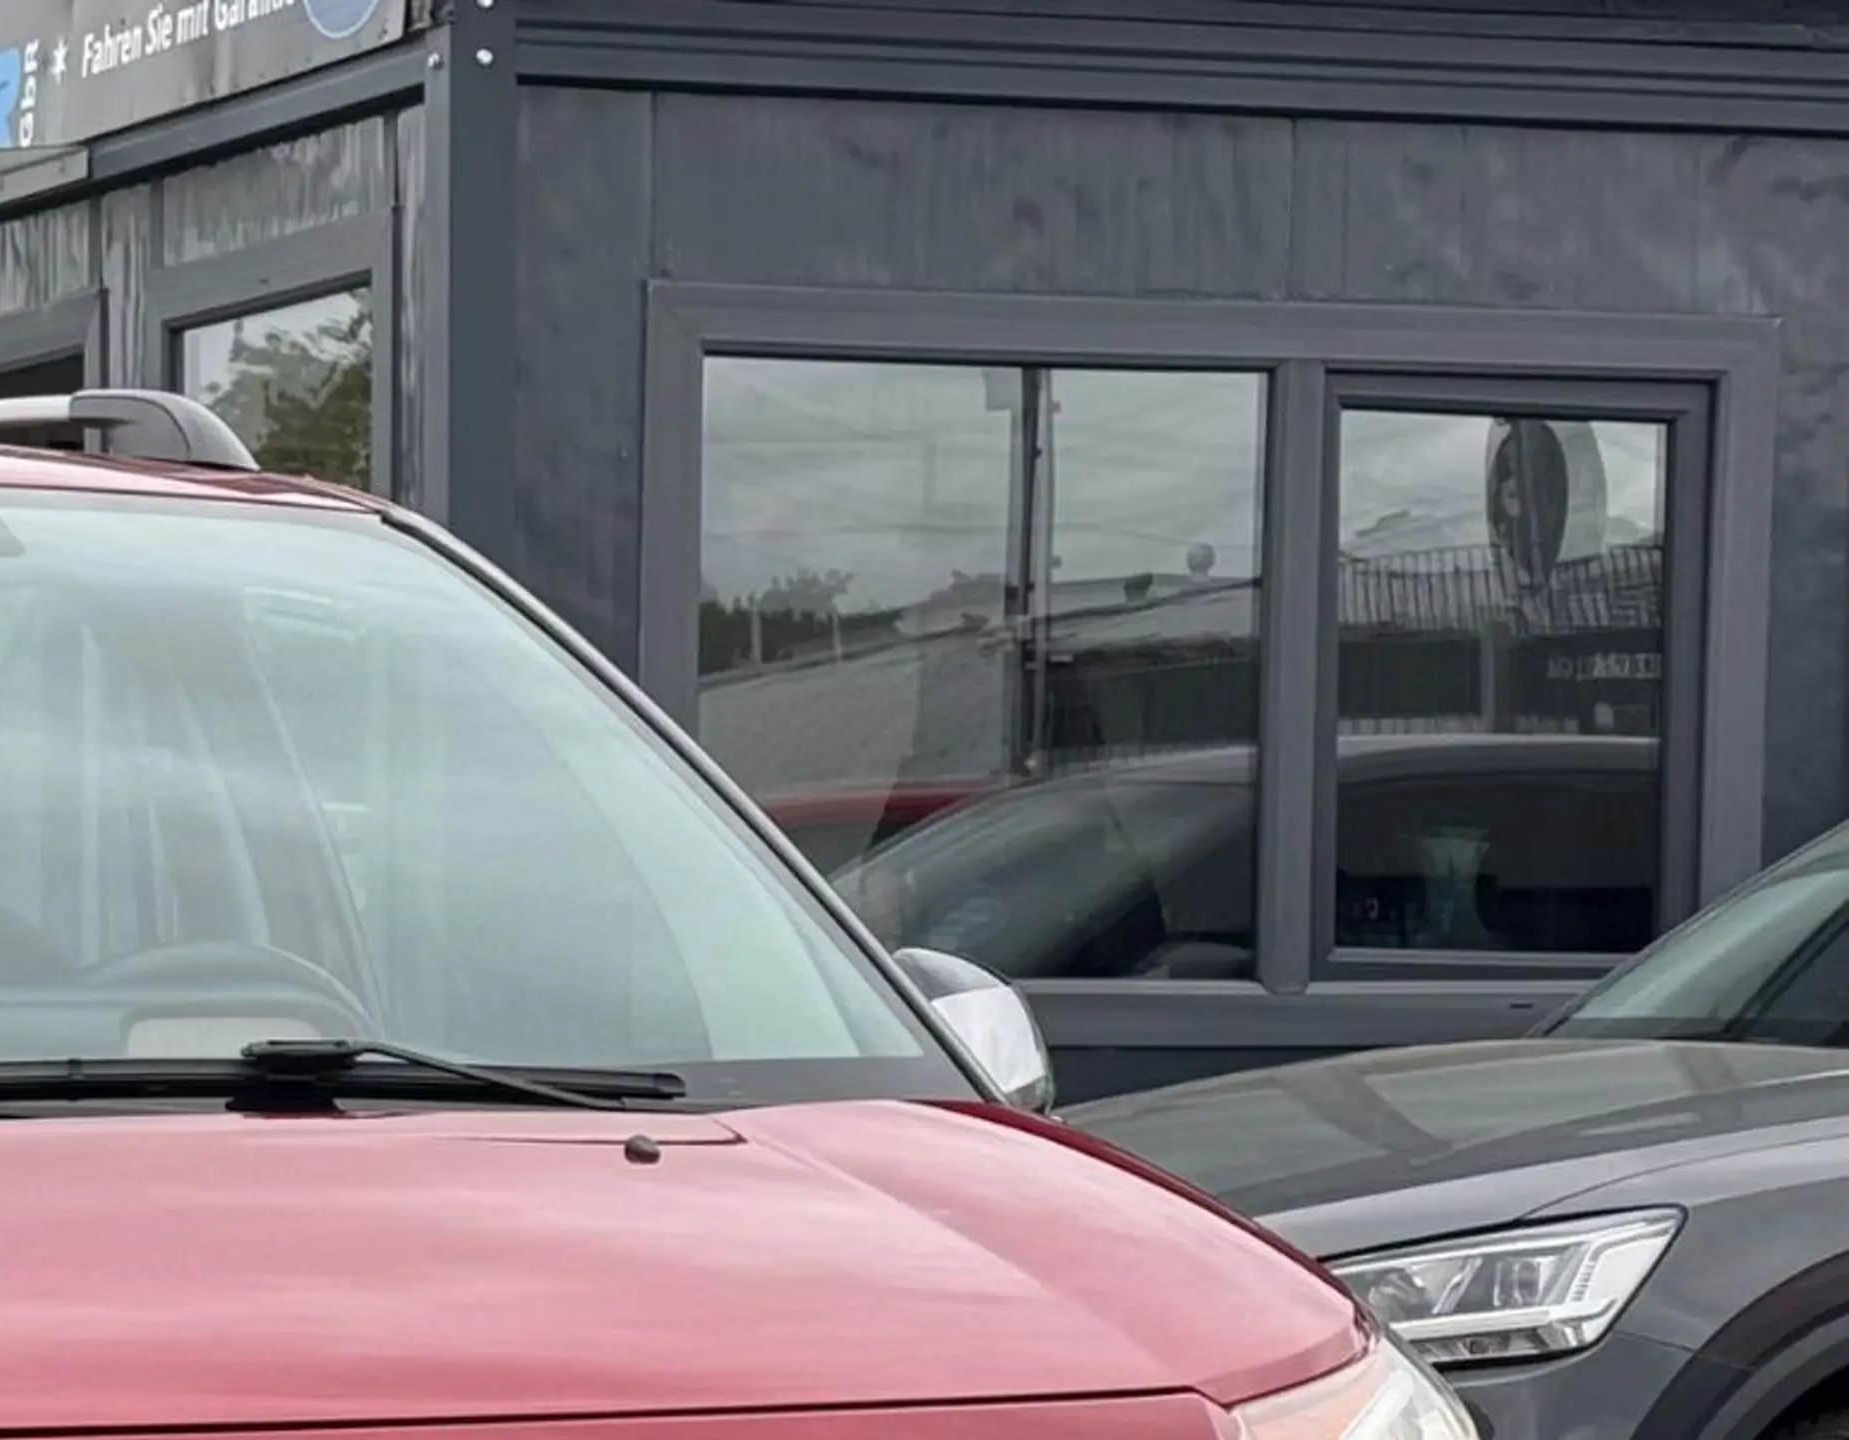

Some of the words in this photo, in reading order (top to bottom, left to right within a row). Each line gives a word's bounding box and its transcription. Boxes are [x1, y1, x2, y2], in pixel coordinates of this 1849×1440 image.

[80, 24, 143, 78] Fahren
[146, 3, 172, 57] Sie
[176, 0, 209, 44] mit
[214, 0, 295, 31] Garan
